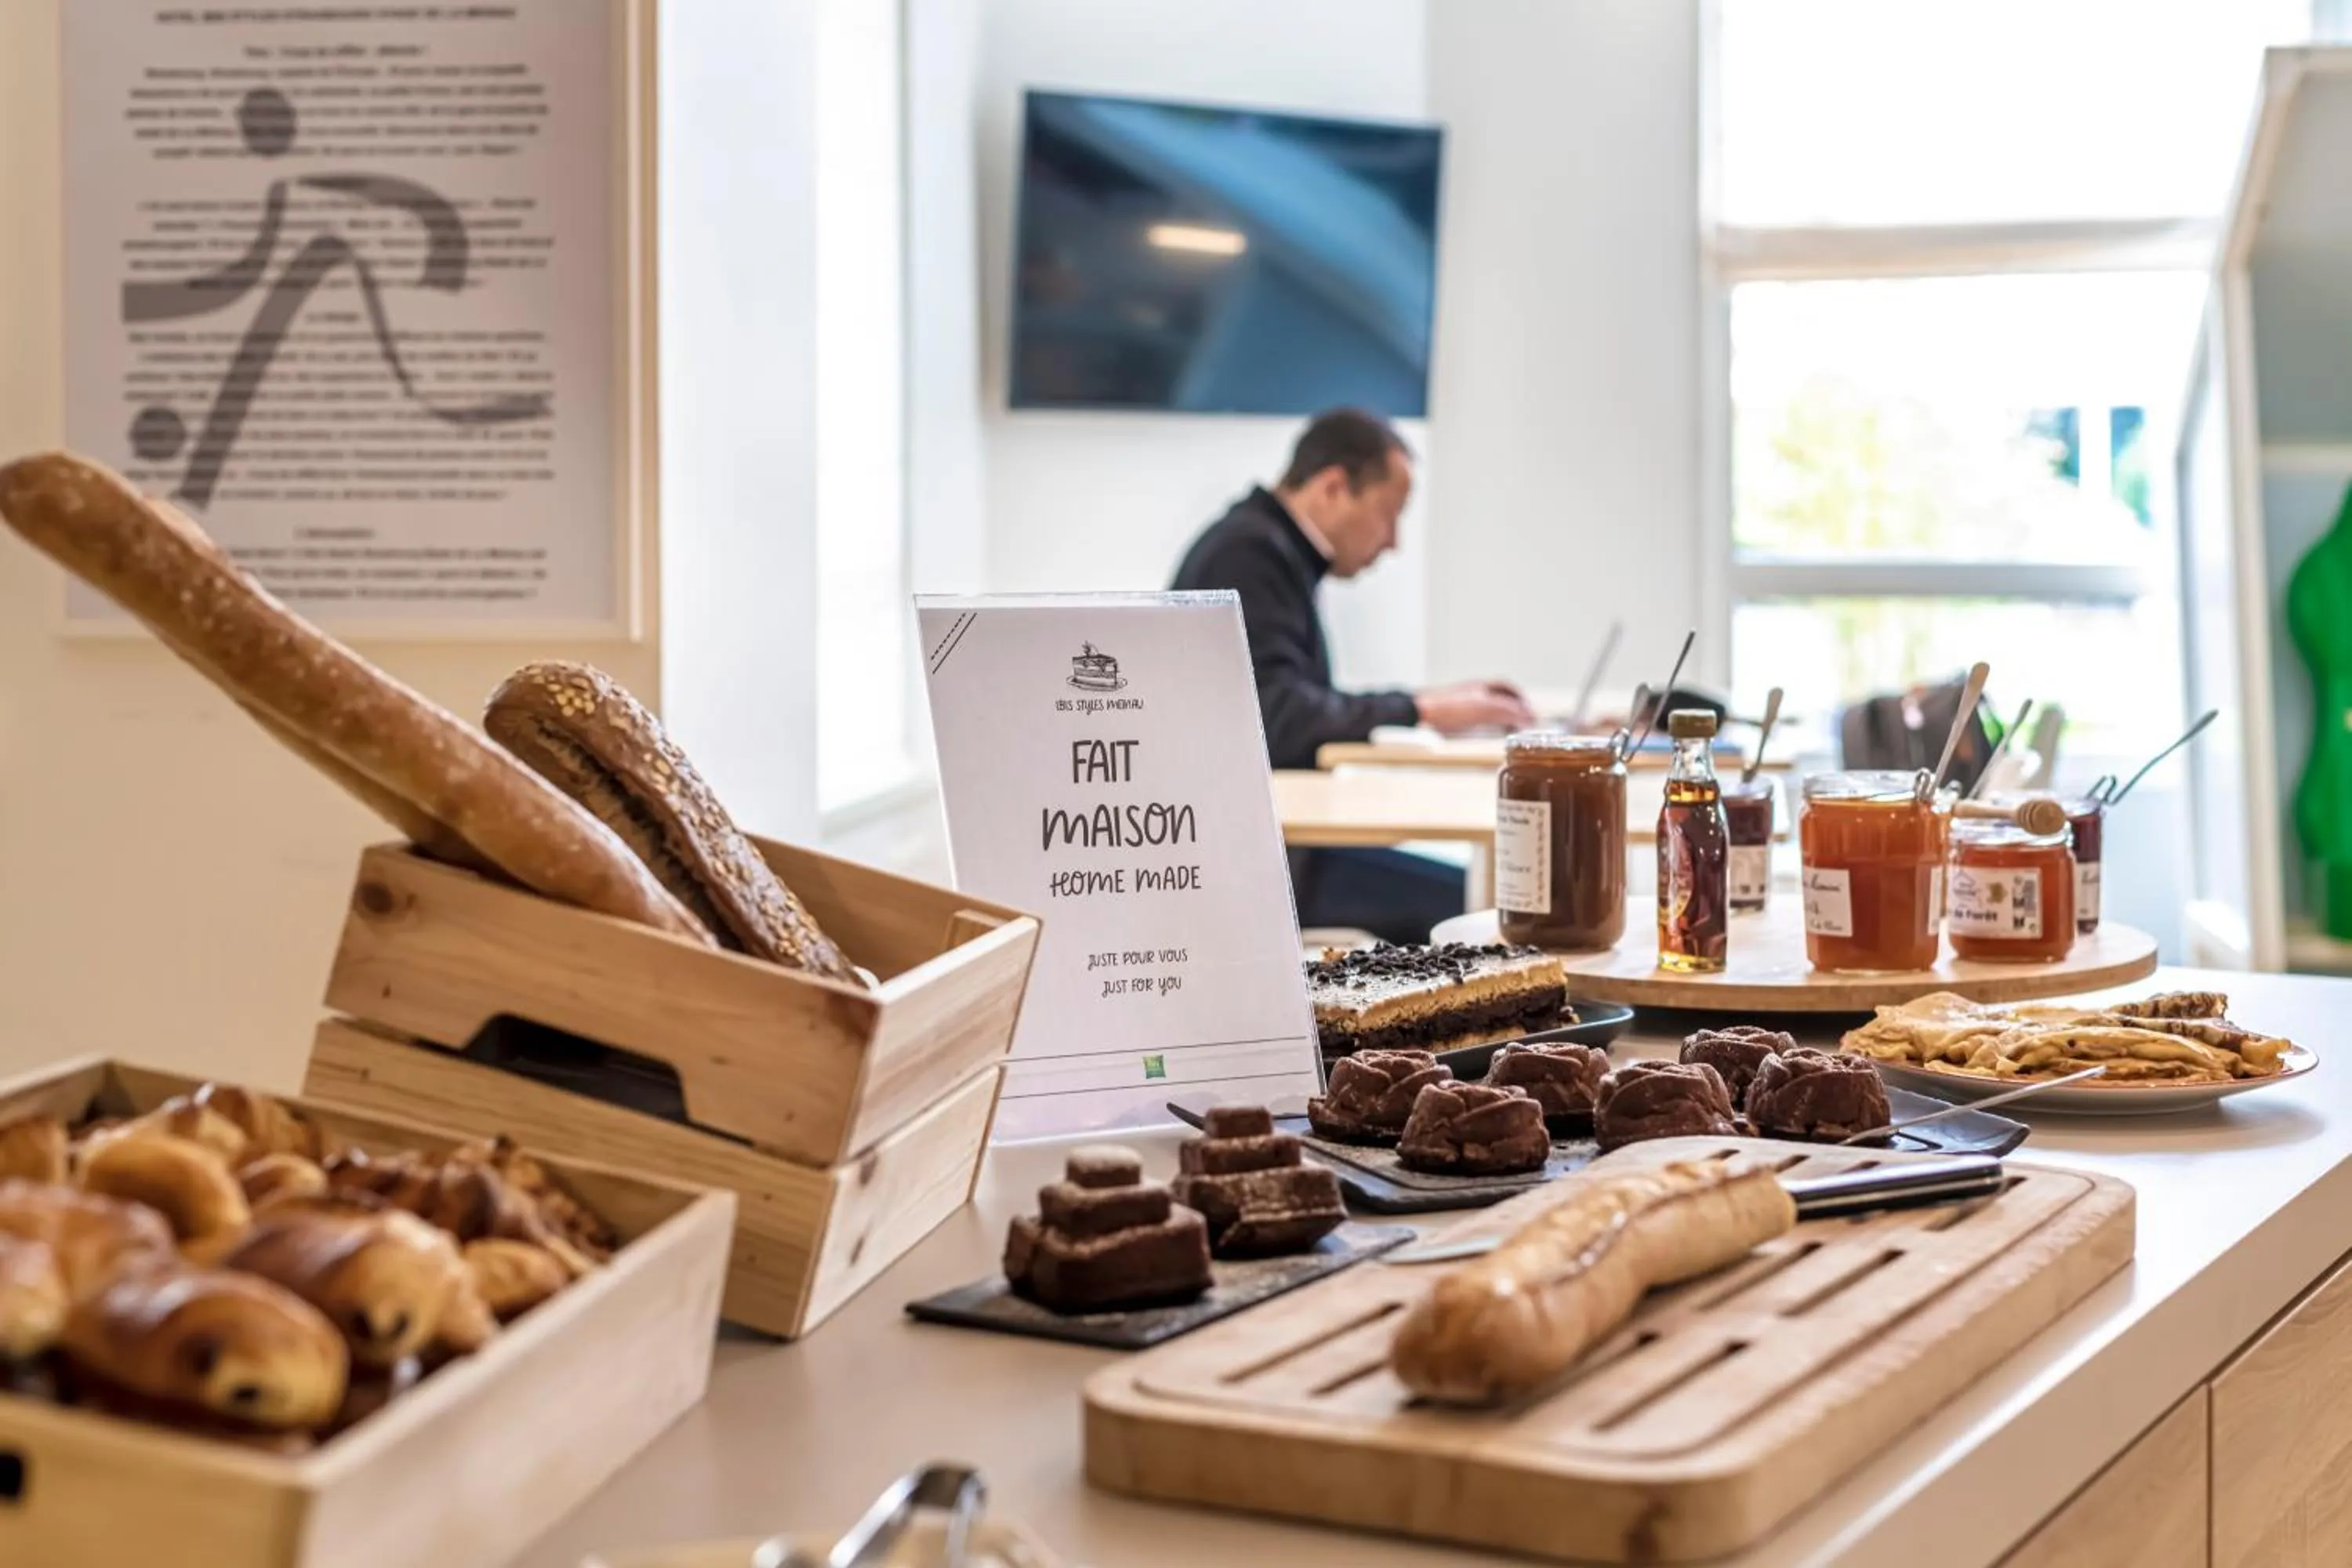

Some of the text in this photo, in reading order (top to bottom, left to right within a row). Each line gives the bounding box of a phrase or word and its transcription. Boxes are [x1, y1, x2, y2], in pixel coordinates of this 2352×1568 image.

[1055, 699, 1073, 712] IBIS
[1076, 699, 1105, 716] STYLES
[1072, 739, 1140, 784] FAIT
[1042, 801, 1196, 851] MAISON
[1049, 865, 1202, 898] HOME MADE
[1087, 948, 1189, 972] JUSTE POUR VOUS
[1101, 975, 1182, 999] JUST FOR YOU
